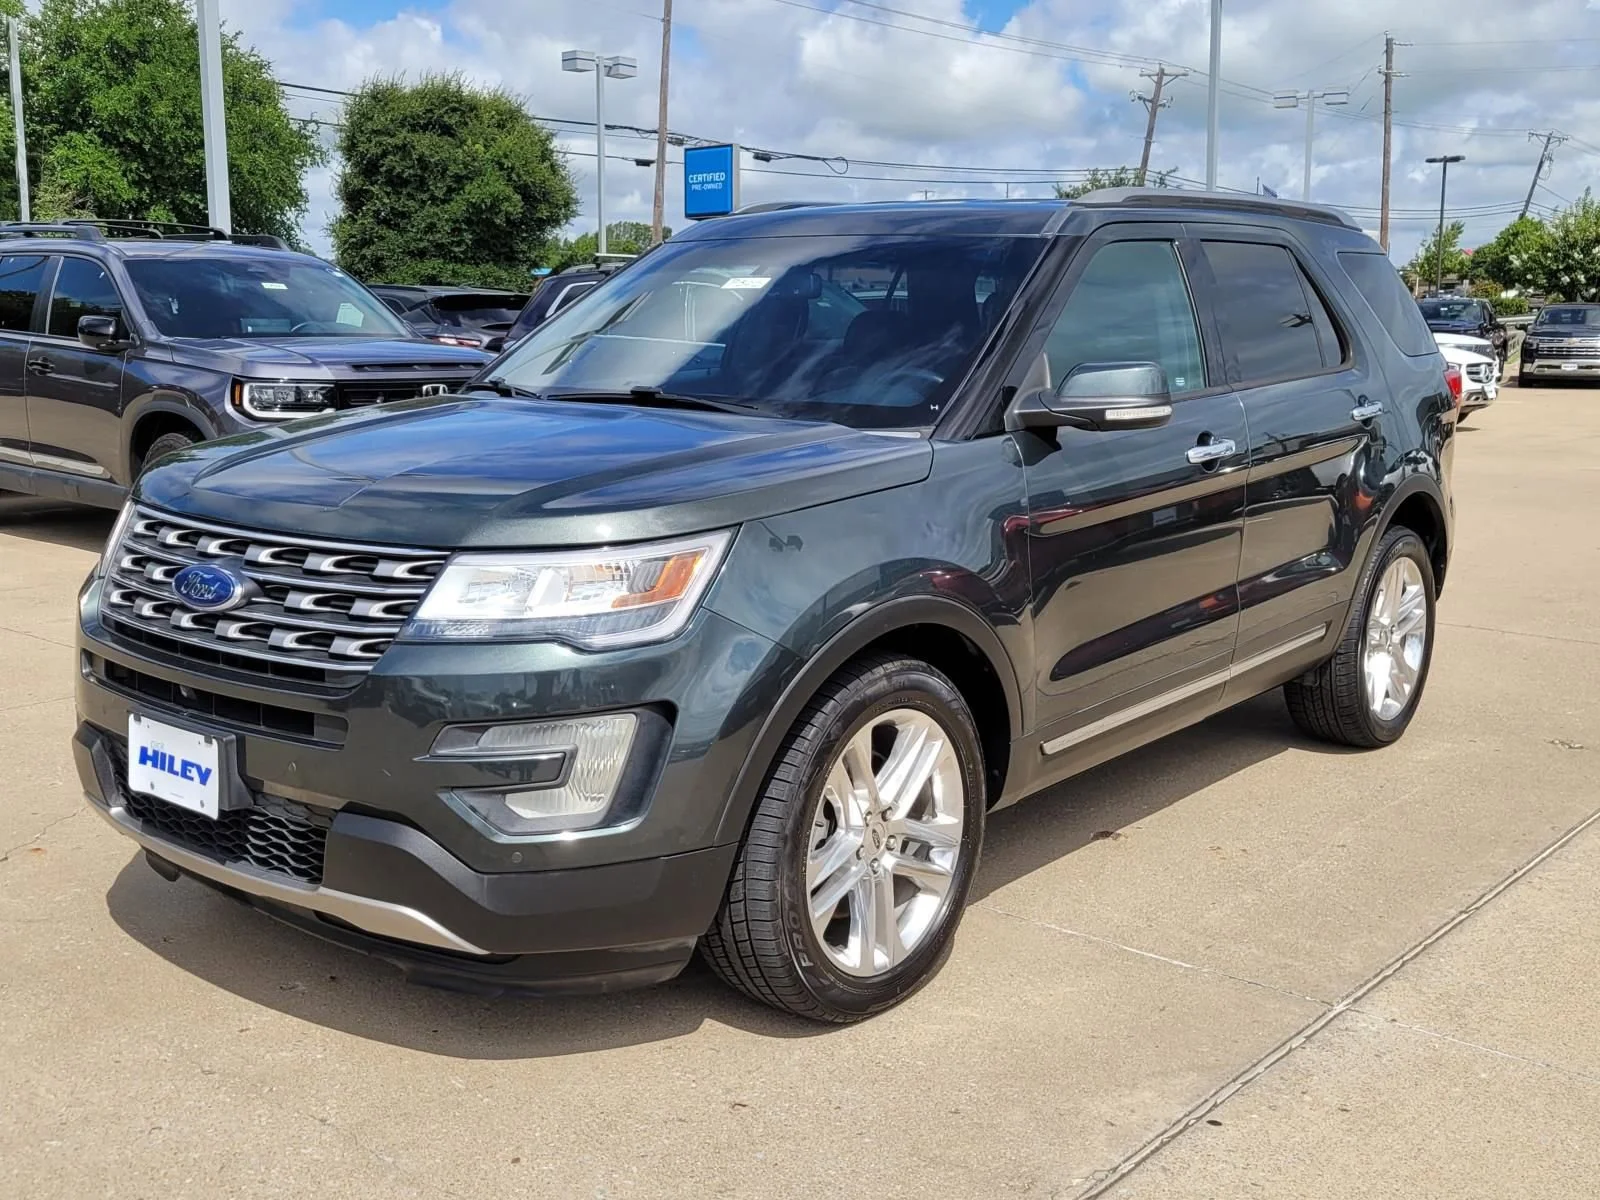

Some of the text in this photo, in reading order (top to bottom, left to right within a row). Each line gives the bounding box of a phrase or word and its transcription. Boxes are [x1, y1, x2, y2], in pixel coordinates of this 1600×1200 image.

[688, 172, 726, 183] CERTIFIED
[691, 183, 723, 191] PRE-OWNED
[181, 570, 221, 600] Ford
[138, 745, 212, 786] HILEY
